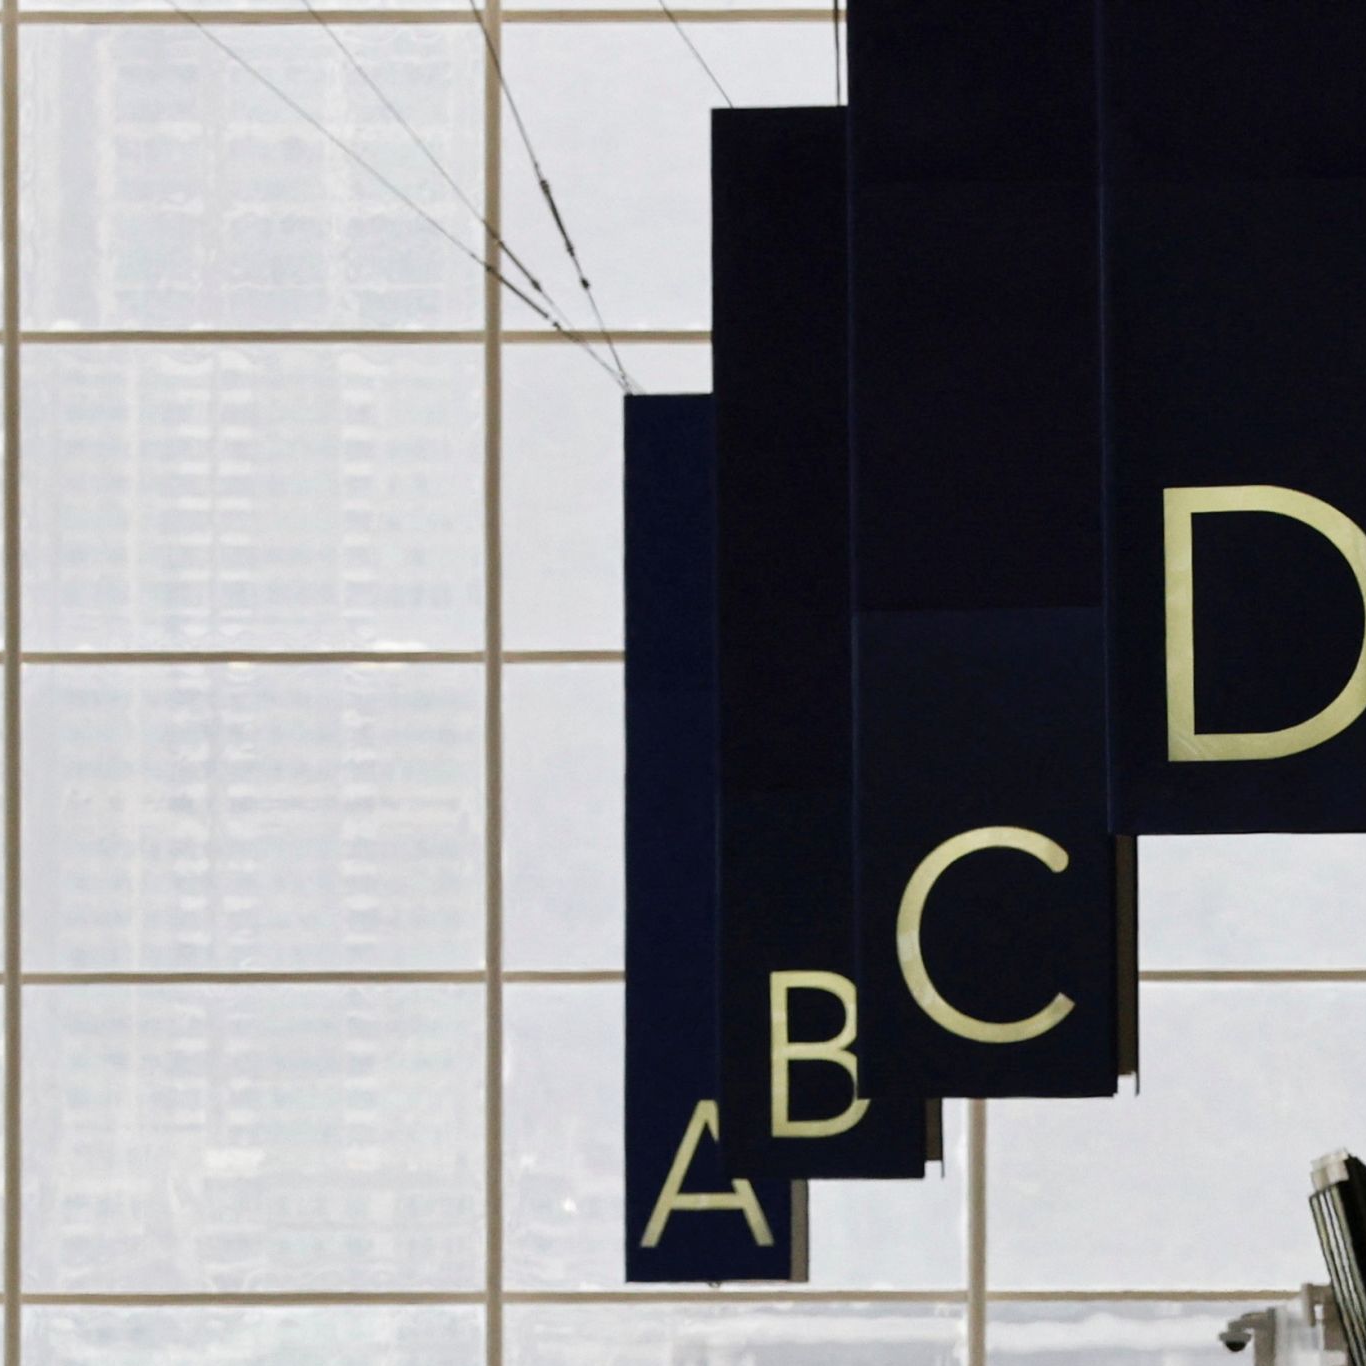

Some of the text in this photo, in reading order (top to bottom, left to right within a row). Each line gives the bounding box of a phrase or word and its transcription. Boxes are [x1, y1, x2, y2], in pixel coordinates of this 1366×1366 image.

[896, 826, 1075, 1043] C
[769, 970, 870, 1137] B
[641, 1100, 772, 1247] A
